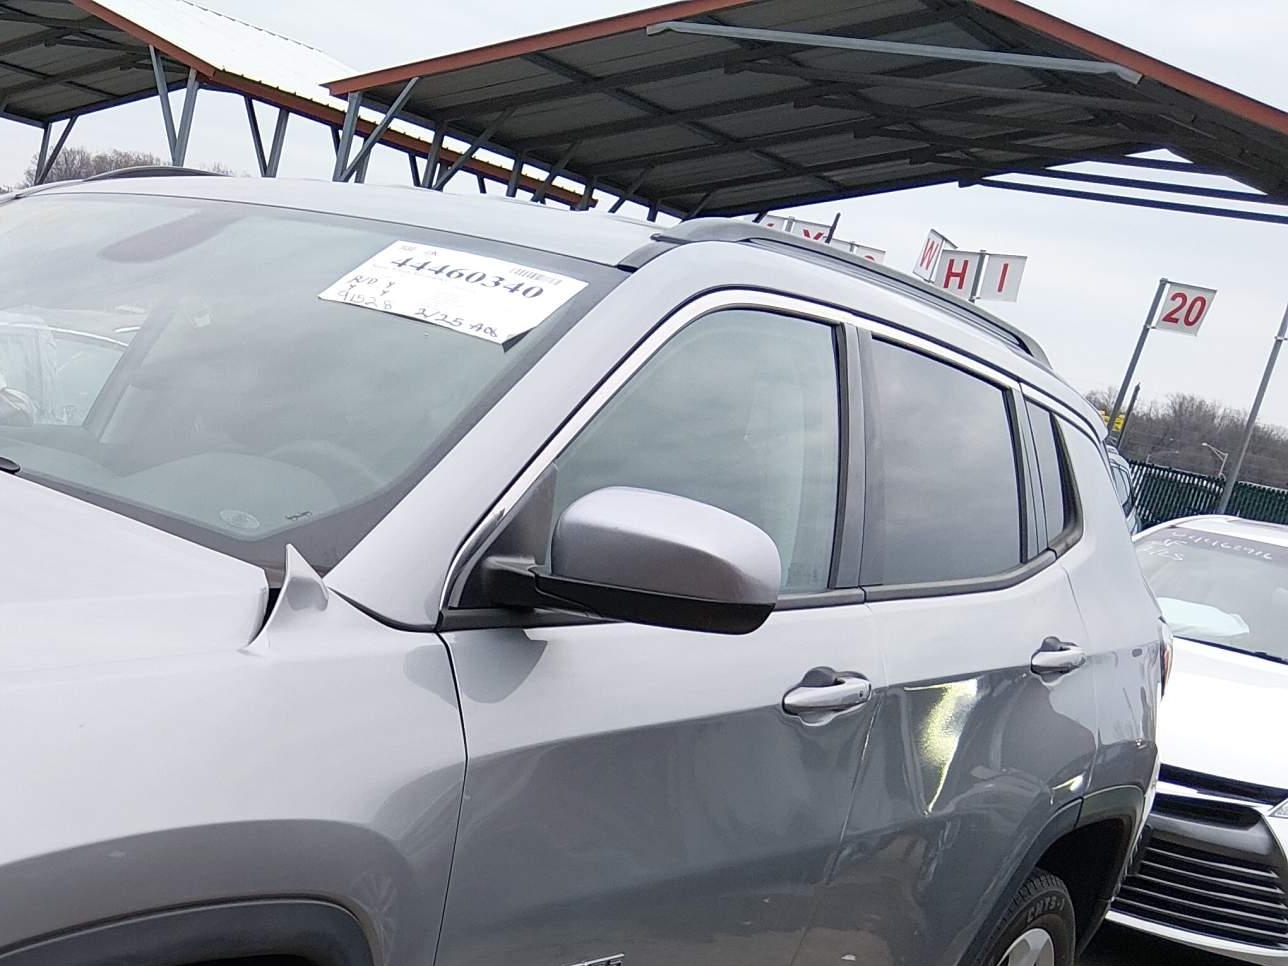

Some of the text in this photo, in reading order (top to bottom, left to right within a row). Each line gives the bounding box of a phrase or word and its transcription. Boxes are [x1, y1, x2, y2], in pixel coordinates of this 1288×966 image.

[918, 238, 939, 271] W
[391, 256, 544, 299] 44460340
[943, 258, 969, 289] H
[997, 262, 1010, 293] I
[1161, 292, 1208, 327] 20
